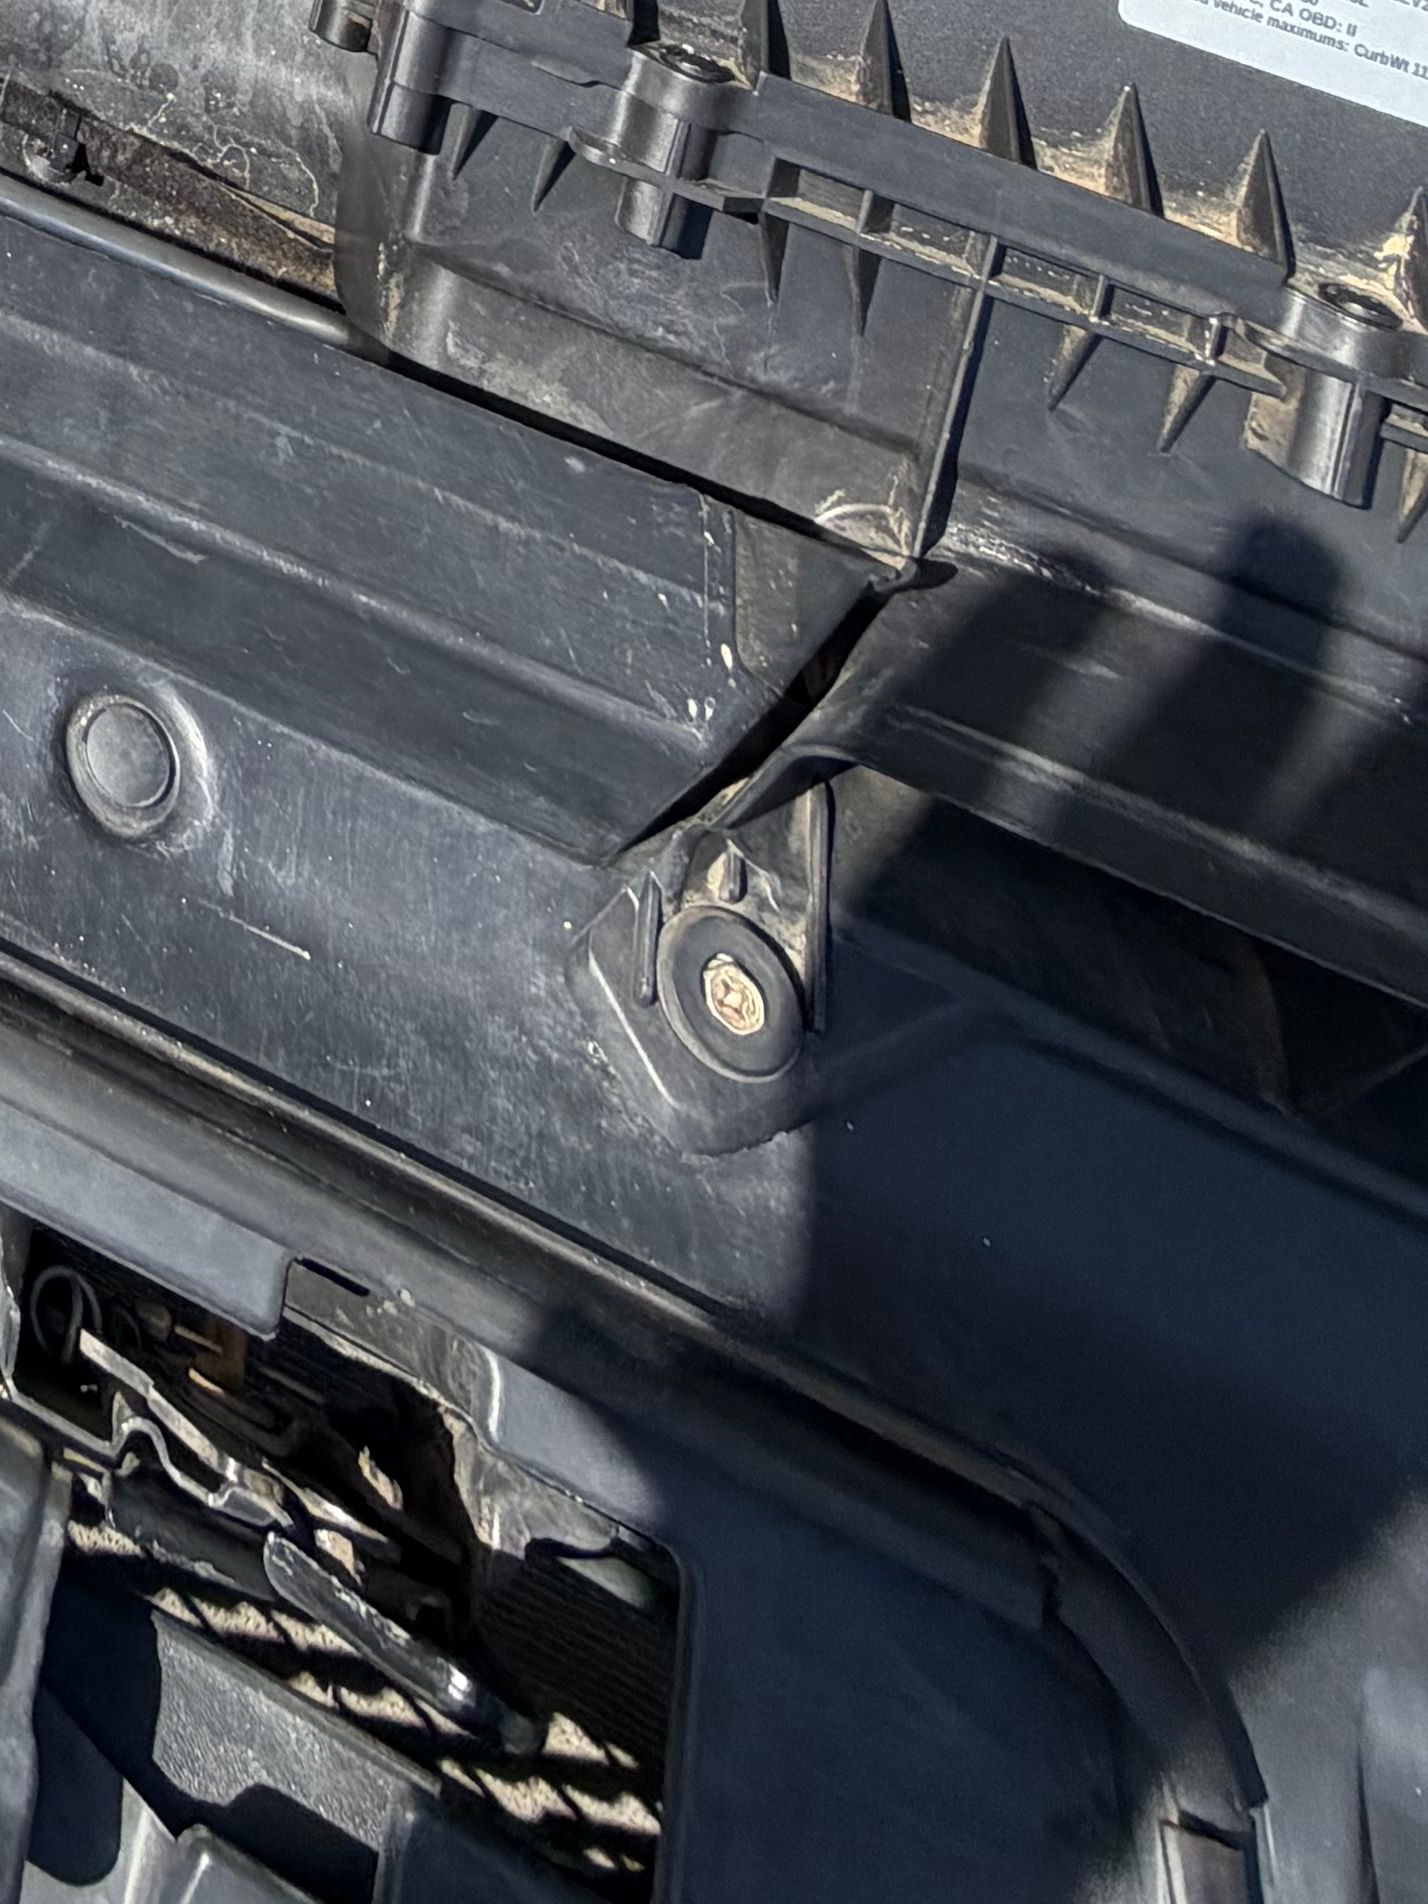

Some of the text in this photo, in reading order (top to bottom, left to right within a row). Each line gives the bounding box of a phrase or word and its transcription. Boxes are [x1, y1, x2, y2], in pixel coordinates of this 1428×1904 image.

[1299, 8, 1342, 32] OBD:
[1266, 14, 1350, 52] maximums:
[1354, 44, 1410, 73] CurbWt
